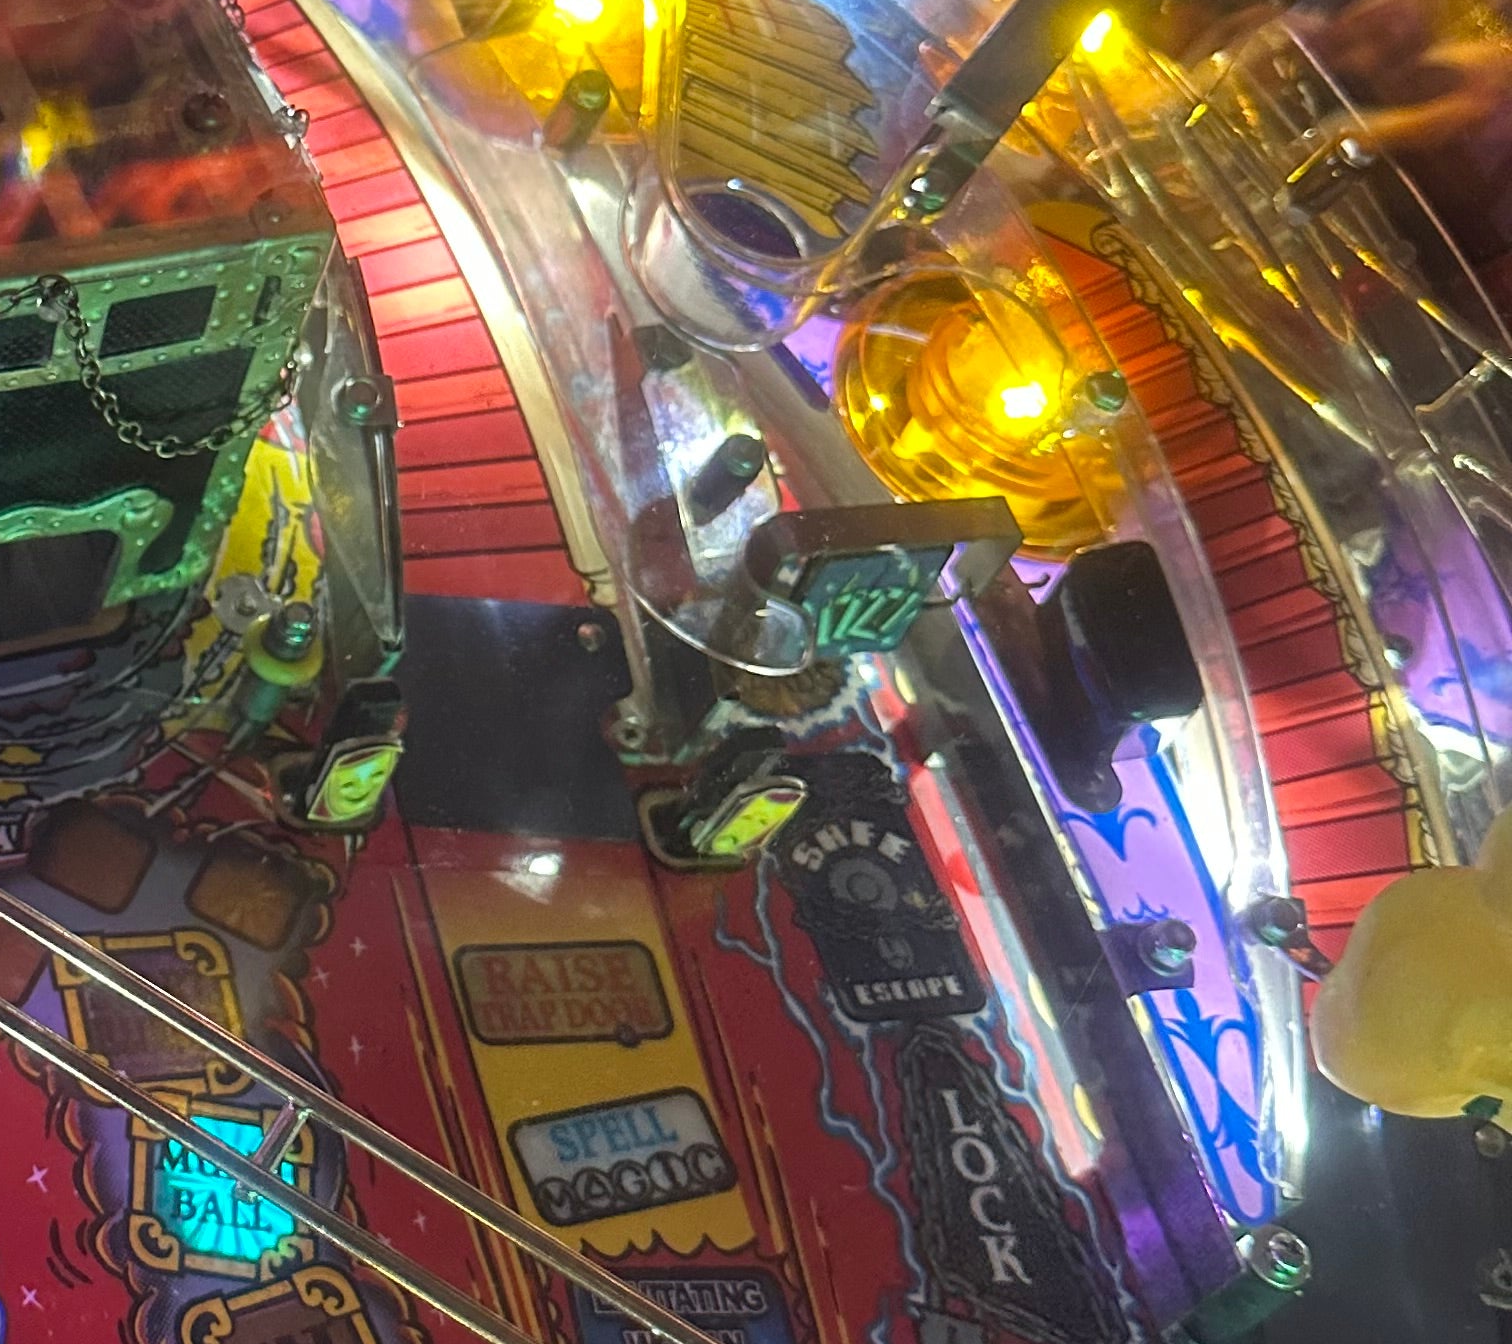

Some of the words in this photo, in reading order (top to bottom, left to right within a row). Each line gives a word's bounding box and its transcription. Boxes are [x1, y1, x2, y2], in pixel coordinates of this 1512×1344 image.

[791, 819, 912, 873] SAFE
[481, 952, 636, 994] RAISE
[852, 974, 965, 1006] ESCAPE
[549, 1104, 680, 1162] SPELL
[538, 1140, 732, 1221] MAGIC
[941, 1089, 1032, 1287] LOCK
[171, 1186, 273, 1232] BALL
